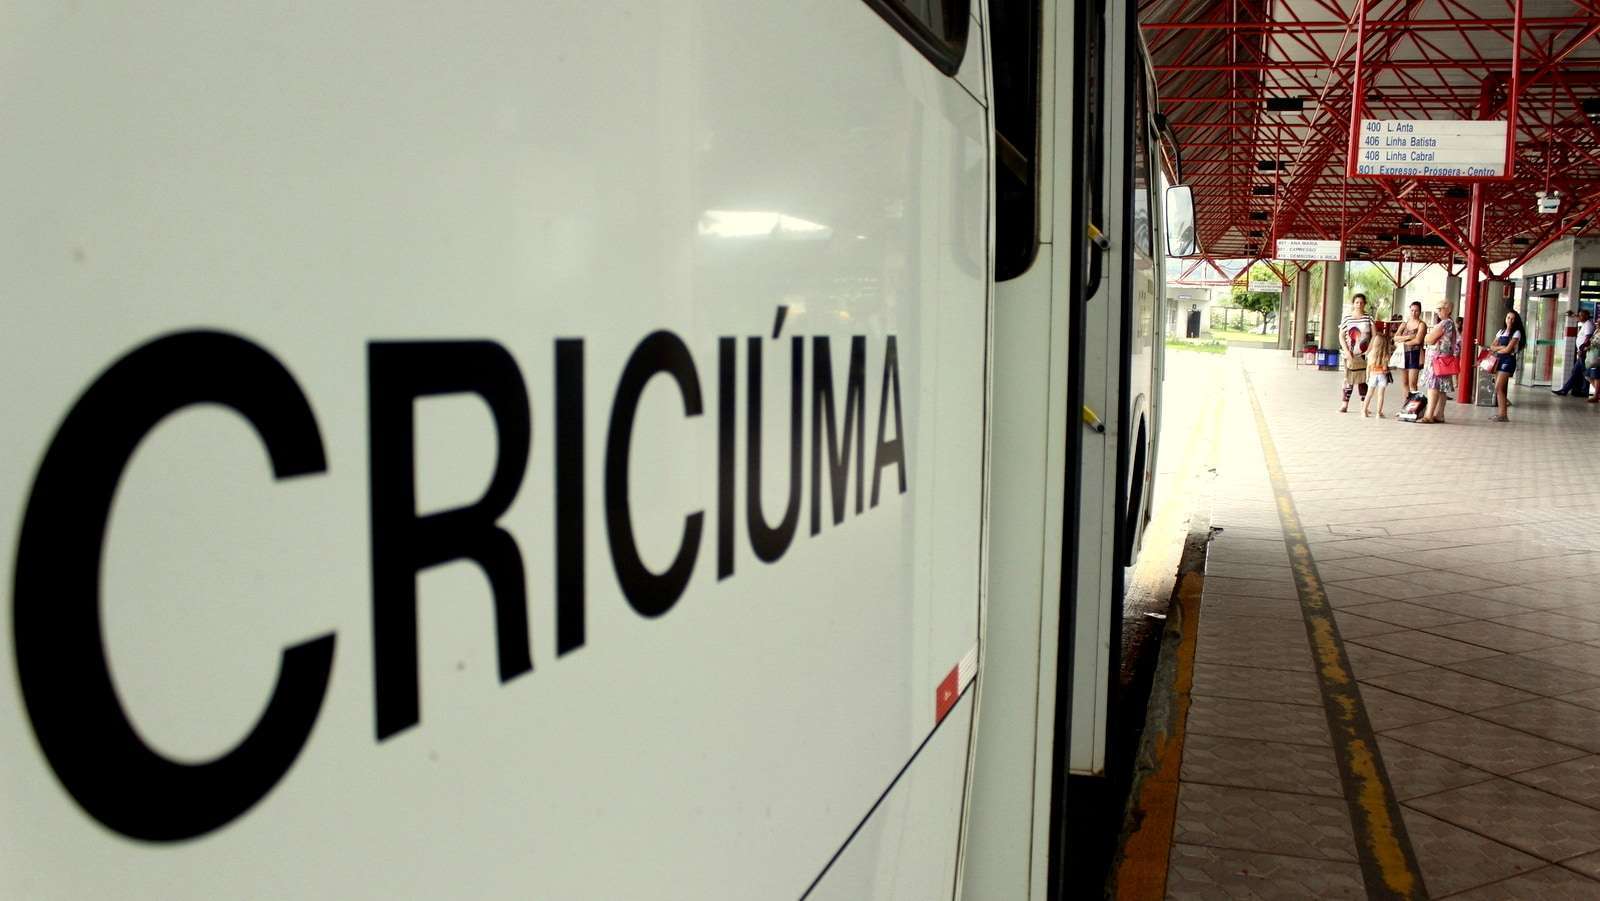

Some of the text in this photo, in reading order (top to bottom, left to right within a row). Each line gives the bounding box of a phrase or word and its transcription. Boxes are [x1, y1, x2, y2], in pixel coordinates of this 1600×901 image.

[1366, 122, 1381, 132] 400
[1396, 122, 1414, 132] Anta
[1365, 136, 1437, 147] 406 Linha Batista
[1365, 150, 1435, 161] 408 Linha Cabral
[1379, 165, 1417, 175] Expresso
[1467, 166, 1495, 176] Centro
[11, 304, 907, 846] CRICIÚMA
